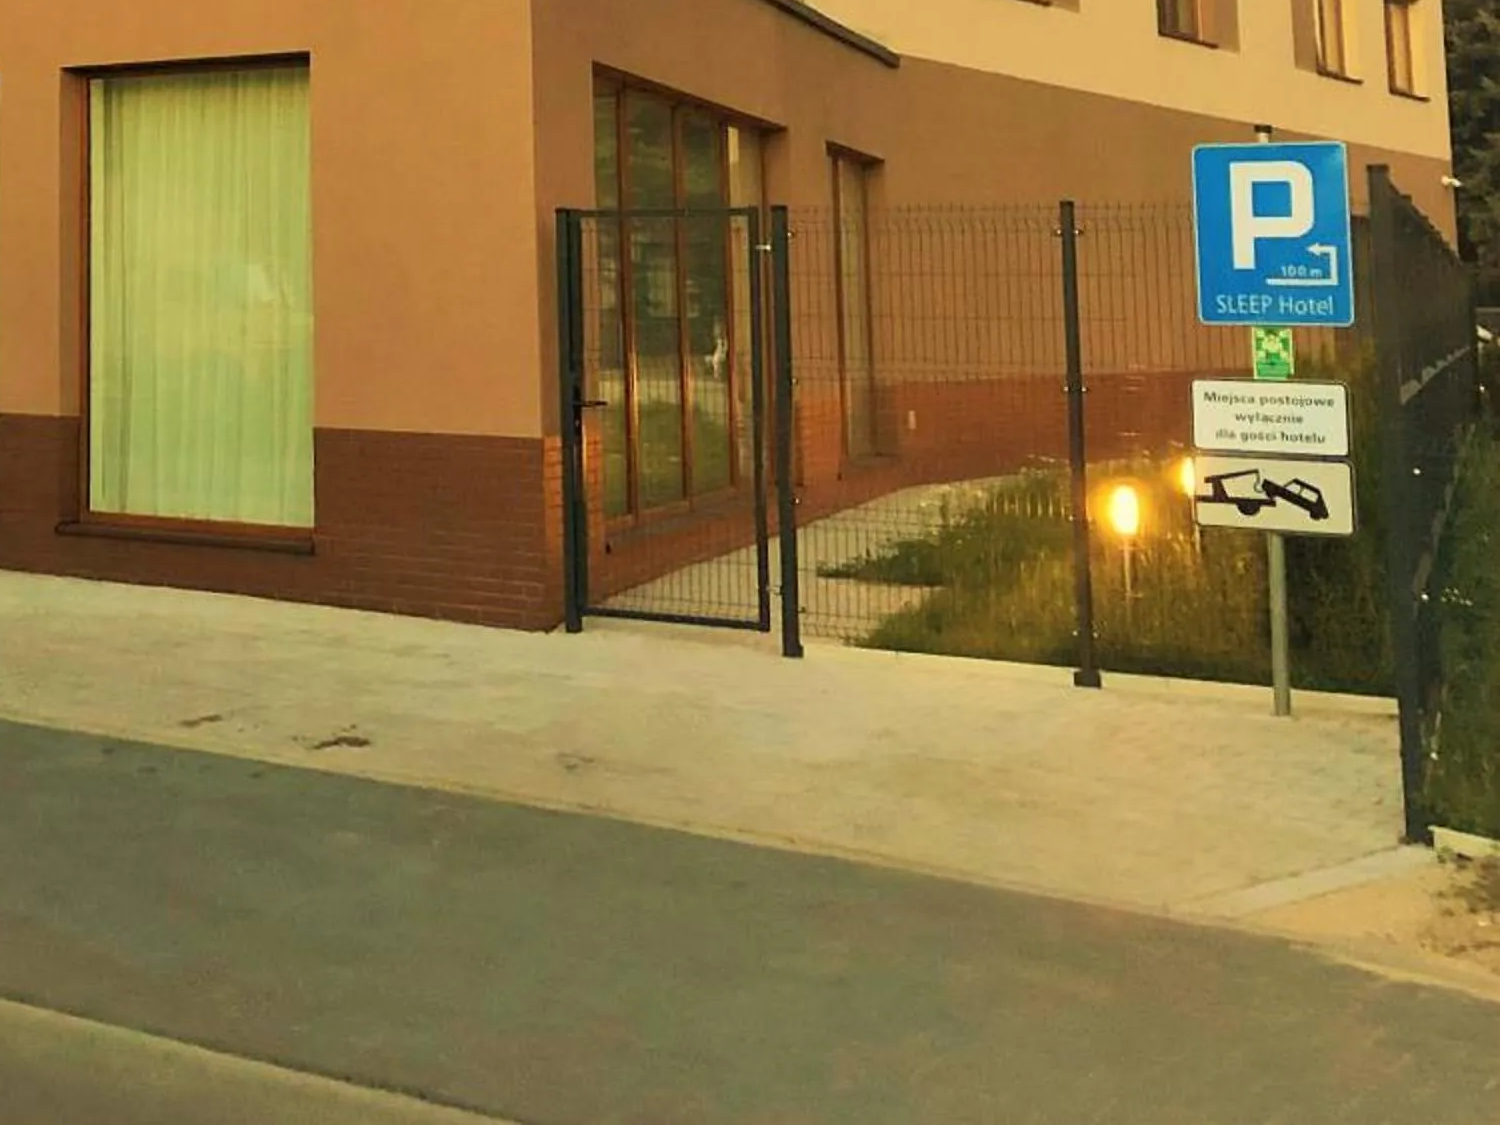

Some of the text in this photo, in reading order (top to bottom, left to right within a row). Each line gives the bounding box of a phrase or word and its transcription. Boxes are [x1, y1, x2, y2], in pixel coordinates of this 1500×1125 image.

[1228, 160, 1315, 270] P
[1216, 294, 1334, 316] SLEEP Hotel
[1203, 391, 1336, 409] Miejsca postojowe
[1281, 431, 1326, 444] hotelu
